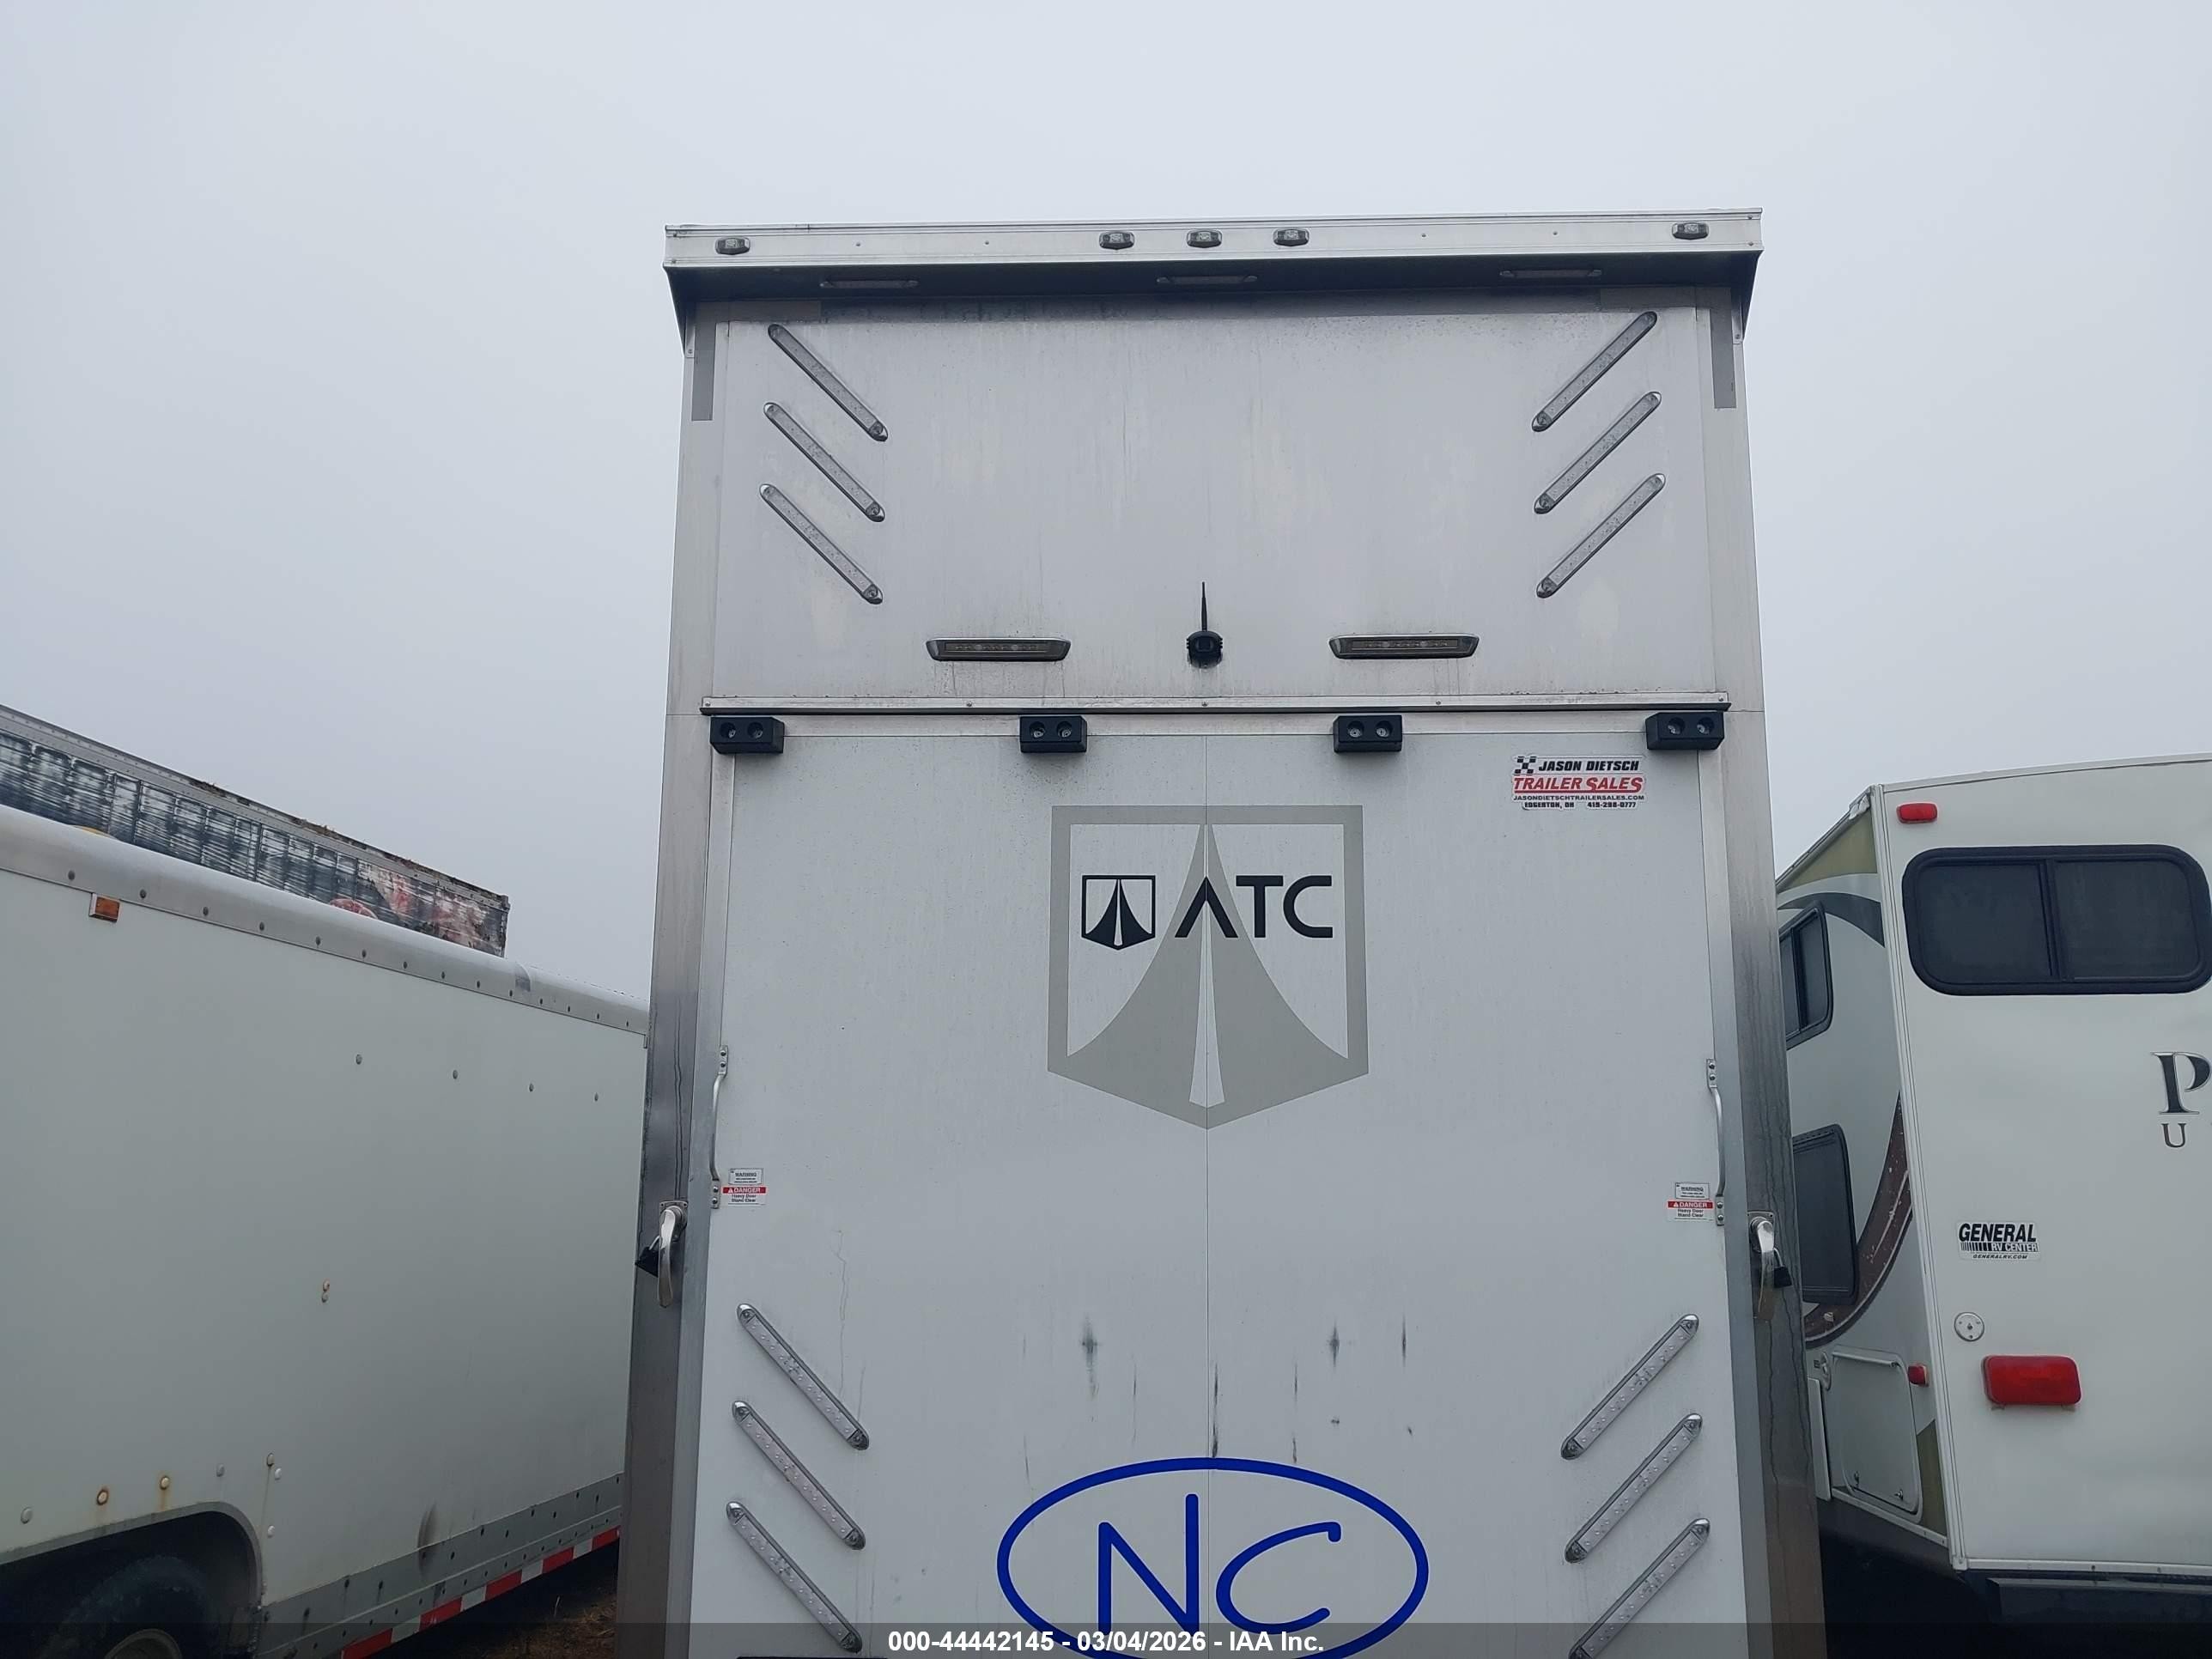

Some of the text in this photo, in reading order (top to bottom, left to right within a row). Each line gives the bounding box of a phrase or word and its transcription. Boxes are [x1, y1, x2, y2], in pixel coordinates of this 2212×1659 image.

[1539, 761, 1639, 771] JASON DIETSCH
[1514, 777, 1643, 793] TRAILER SALES
[1175, 875, 1334, 938] ATC
[1959, 1223, 2036, 1242] GENERAL
[1990, 1243, 2038, 1251] RV CENTER
